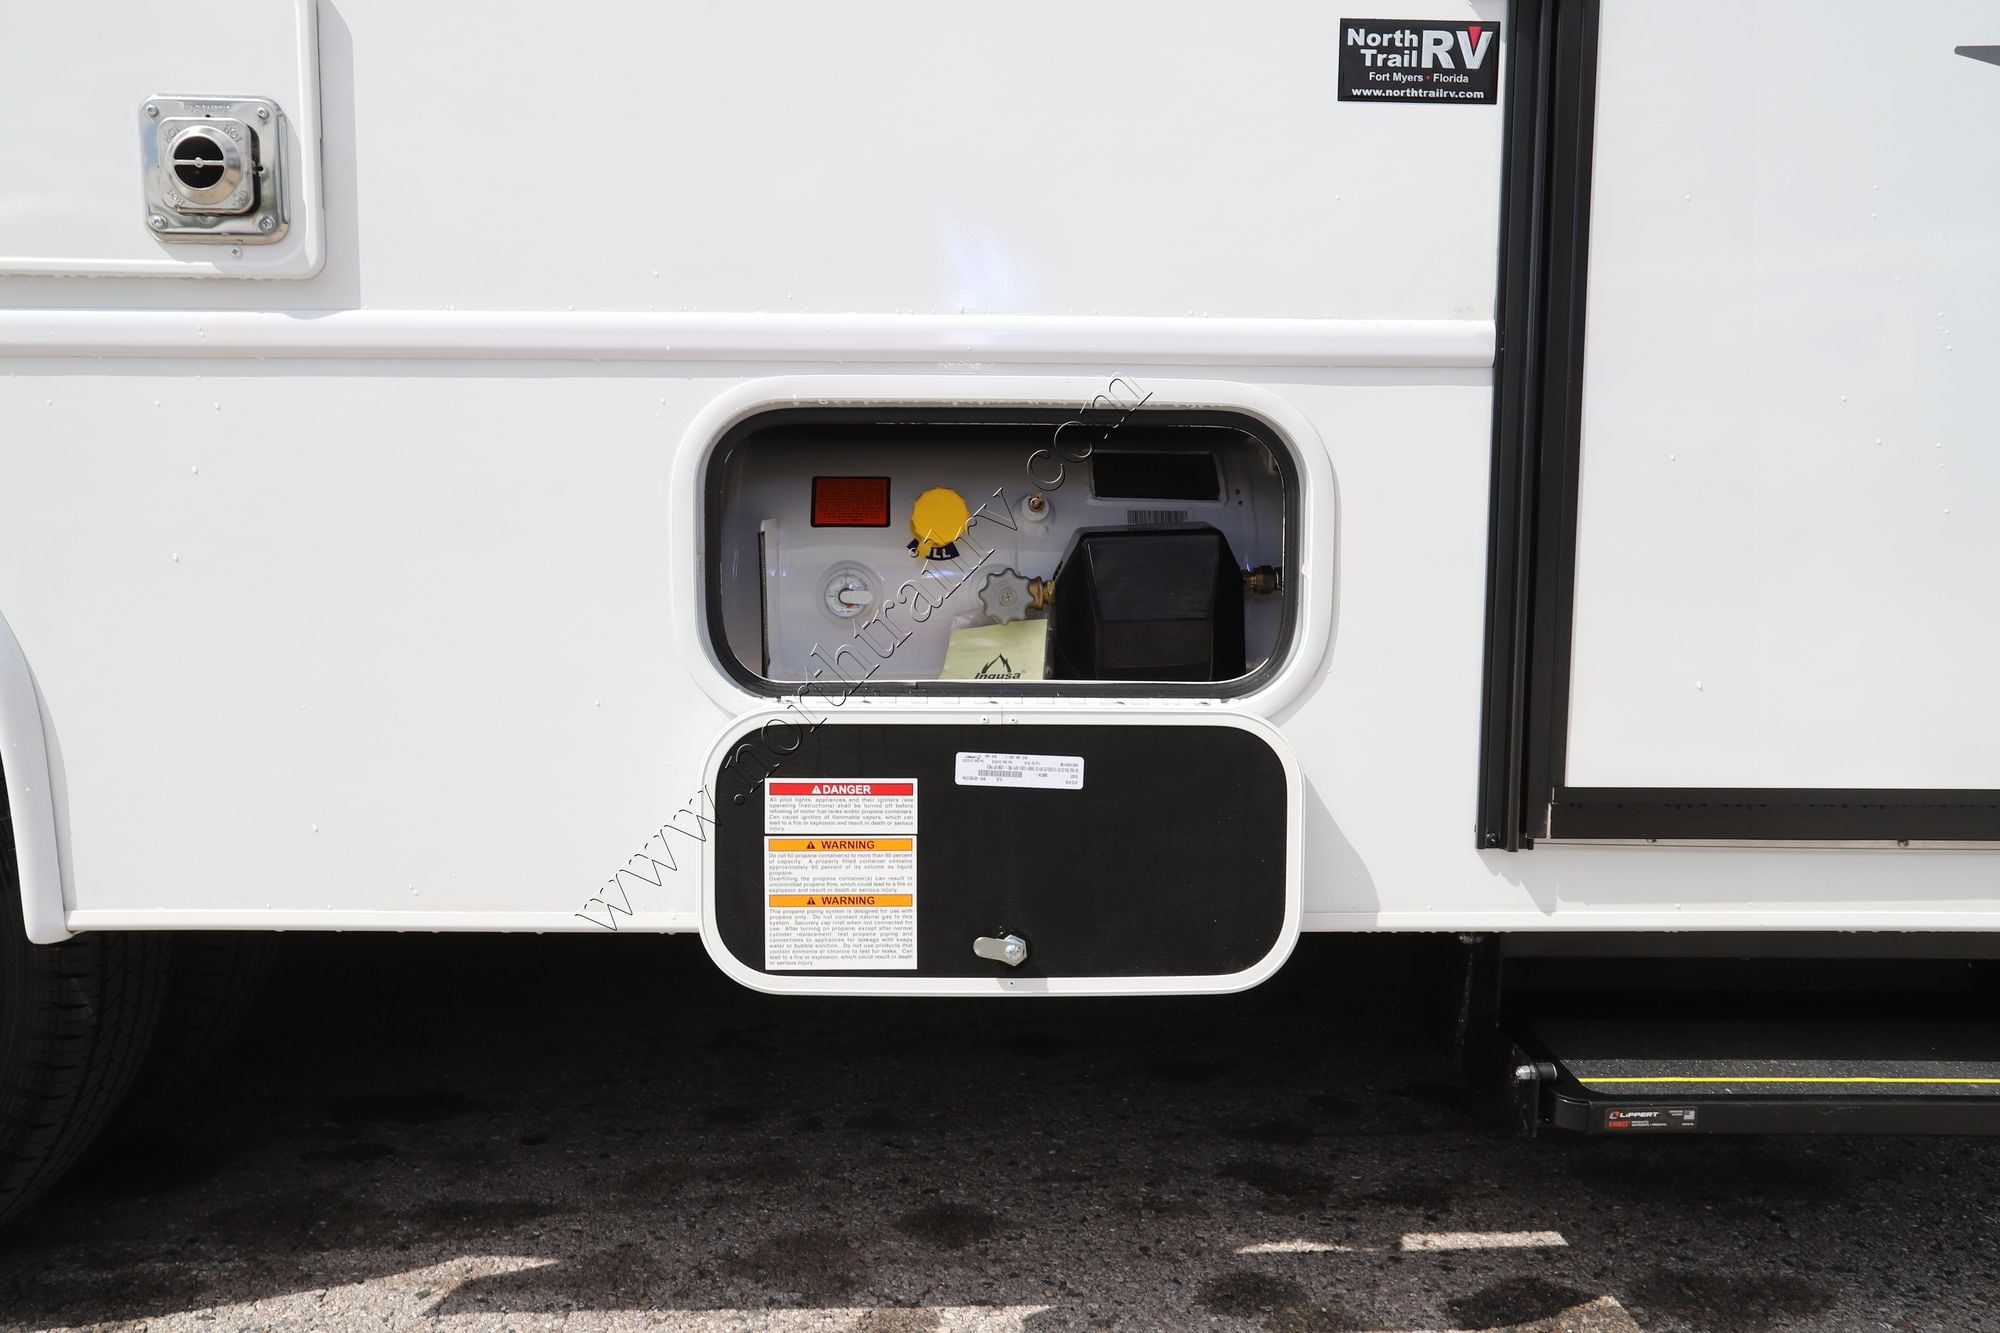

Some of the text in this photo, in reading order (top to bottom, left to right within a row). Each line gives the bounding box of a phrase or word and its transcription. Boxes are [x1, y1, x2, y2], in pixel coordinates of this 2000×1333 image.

[1347, 28, 1418, 47] North
[1421, 29, 1493, 69] RV
[1360, 49, 1417, 68] Trail
[1369, 72, 1469, 83] Fort Myers Florida
[1351, 87, 1484, 99] www.northtrailrv.com
[823, 784, 871, 795] DANGER
[821, 840, 875, 849] WARNING
[821, 896, 875, 905] WARNING
